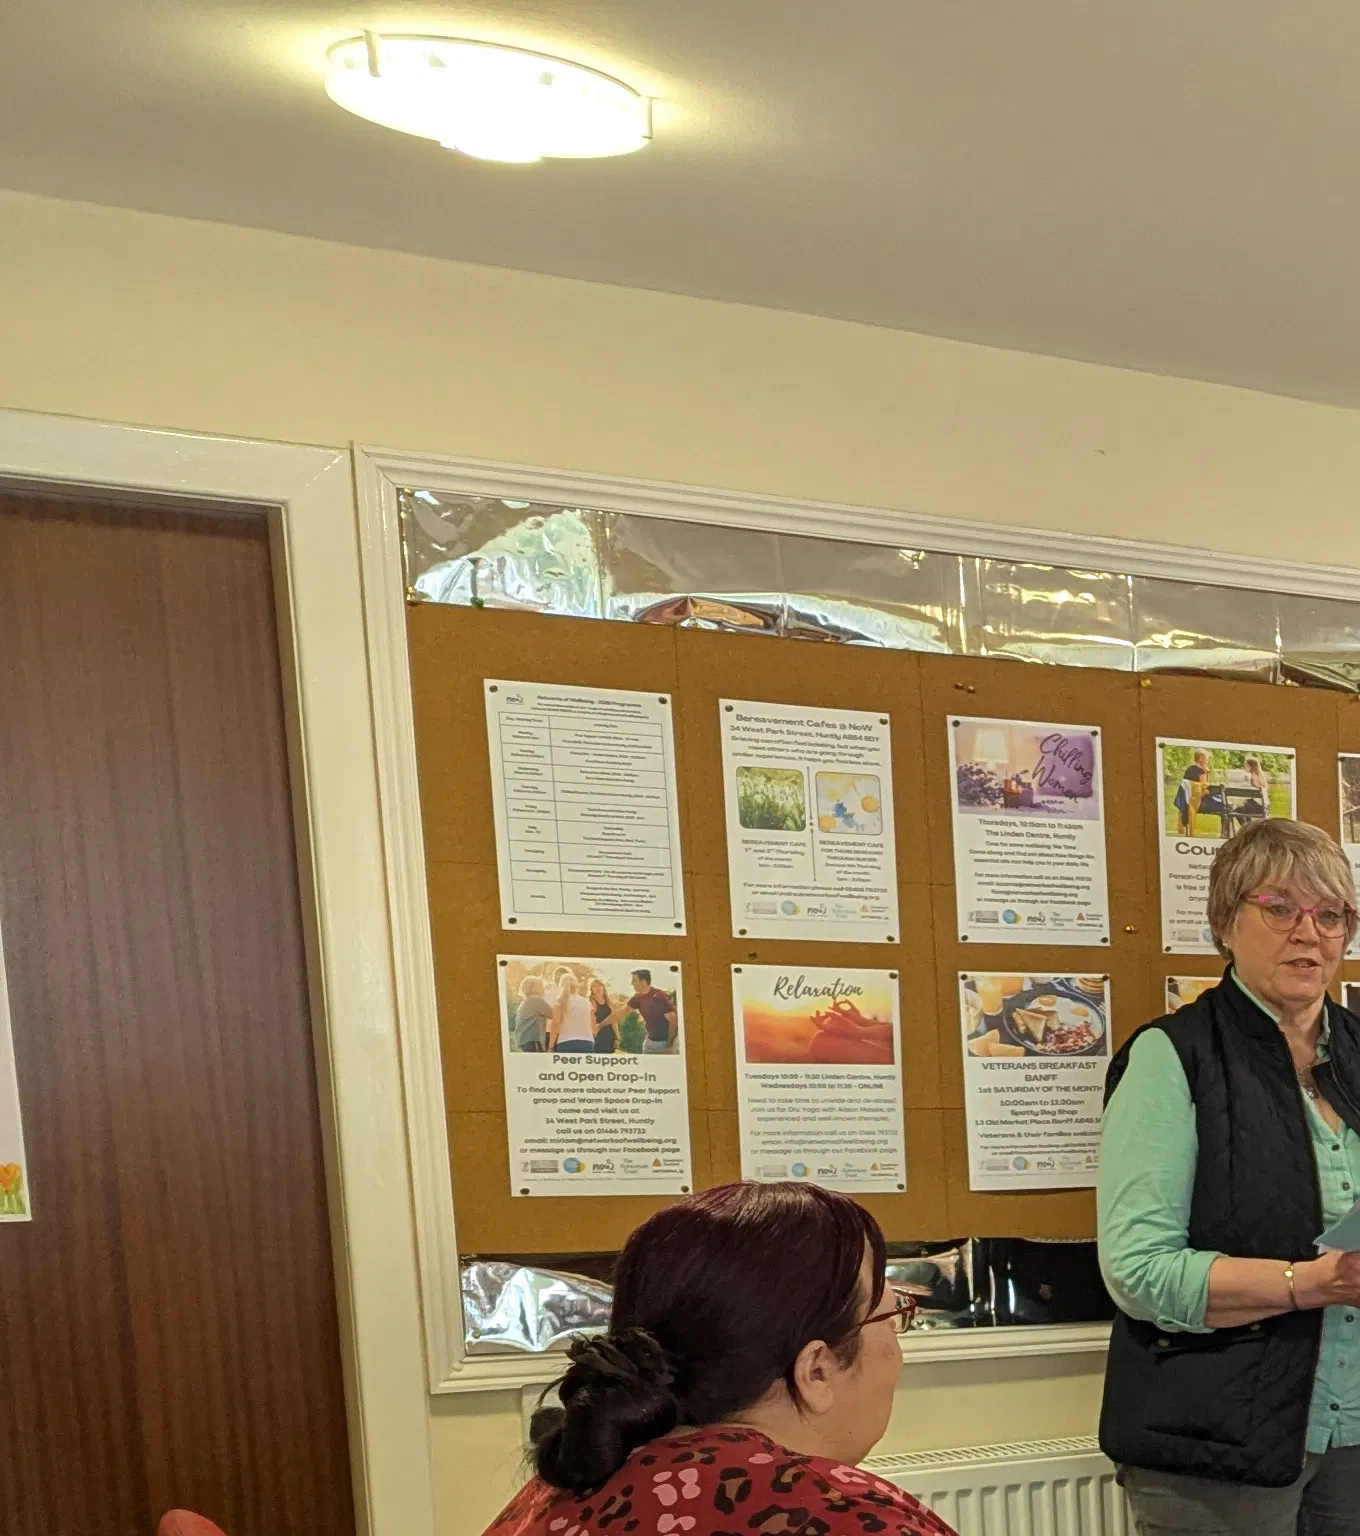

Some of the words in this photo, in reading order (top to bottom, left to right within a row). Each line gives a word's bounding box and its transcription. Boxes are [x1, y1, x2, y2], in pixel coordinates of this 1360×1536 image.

[736, 714, 804, 726] Bereavement
[806, 720, 837, 728] Cafes
[816, 732, 841, 740] Huntly
[1040, 733, 1093, 785] Chilling
[1032, 756, 1078, 804] Women
[774, 975, 863, 1000] Relaxation
[553, 1055, 582, 1064] Peer
[586, 1055, 638, 1067] Support
[1039, 1062, 1097, 1070] BREAKFAST
[539, 1072, 565, 1081] and
[568, 1072, 603, 1083] Open
[1025, 1074, 1058, 1082] BANFF
